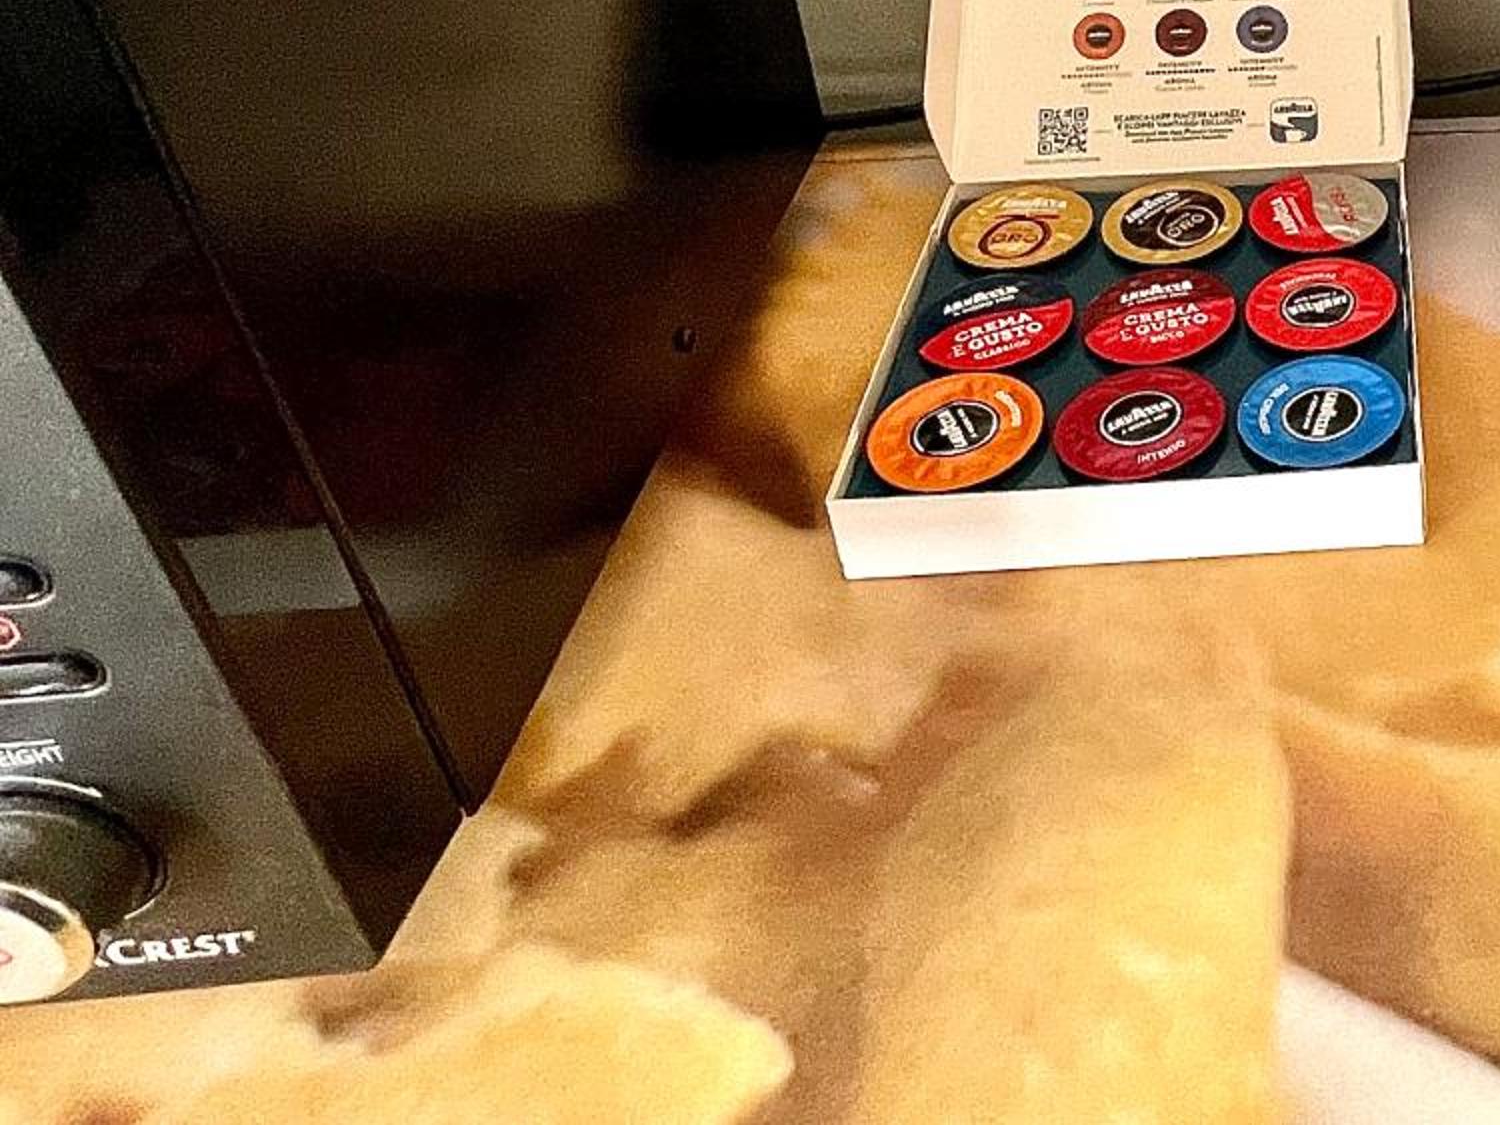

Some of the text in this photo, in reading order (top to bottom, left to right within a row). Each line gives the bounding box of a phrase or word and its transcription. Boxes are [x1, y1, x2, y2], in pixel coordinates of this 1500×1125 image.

[1167, 214, 1205, 238] ORO
[943, 285, 1020, 316] LAVAZZA
[1120, 280, 1193, 304] LAVAZZA
[954, 312, 1033, 342] CREMA
[1120, 313, 1209, 342] E GUSTO
[1123, 302, 1200, 326] CREMA
[952, 322, 1043, 358] E GUSTO
[1107, 401, 1173, 433] LAVAZZA
